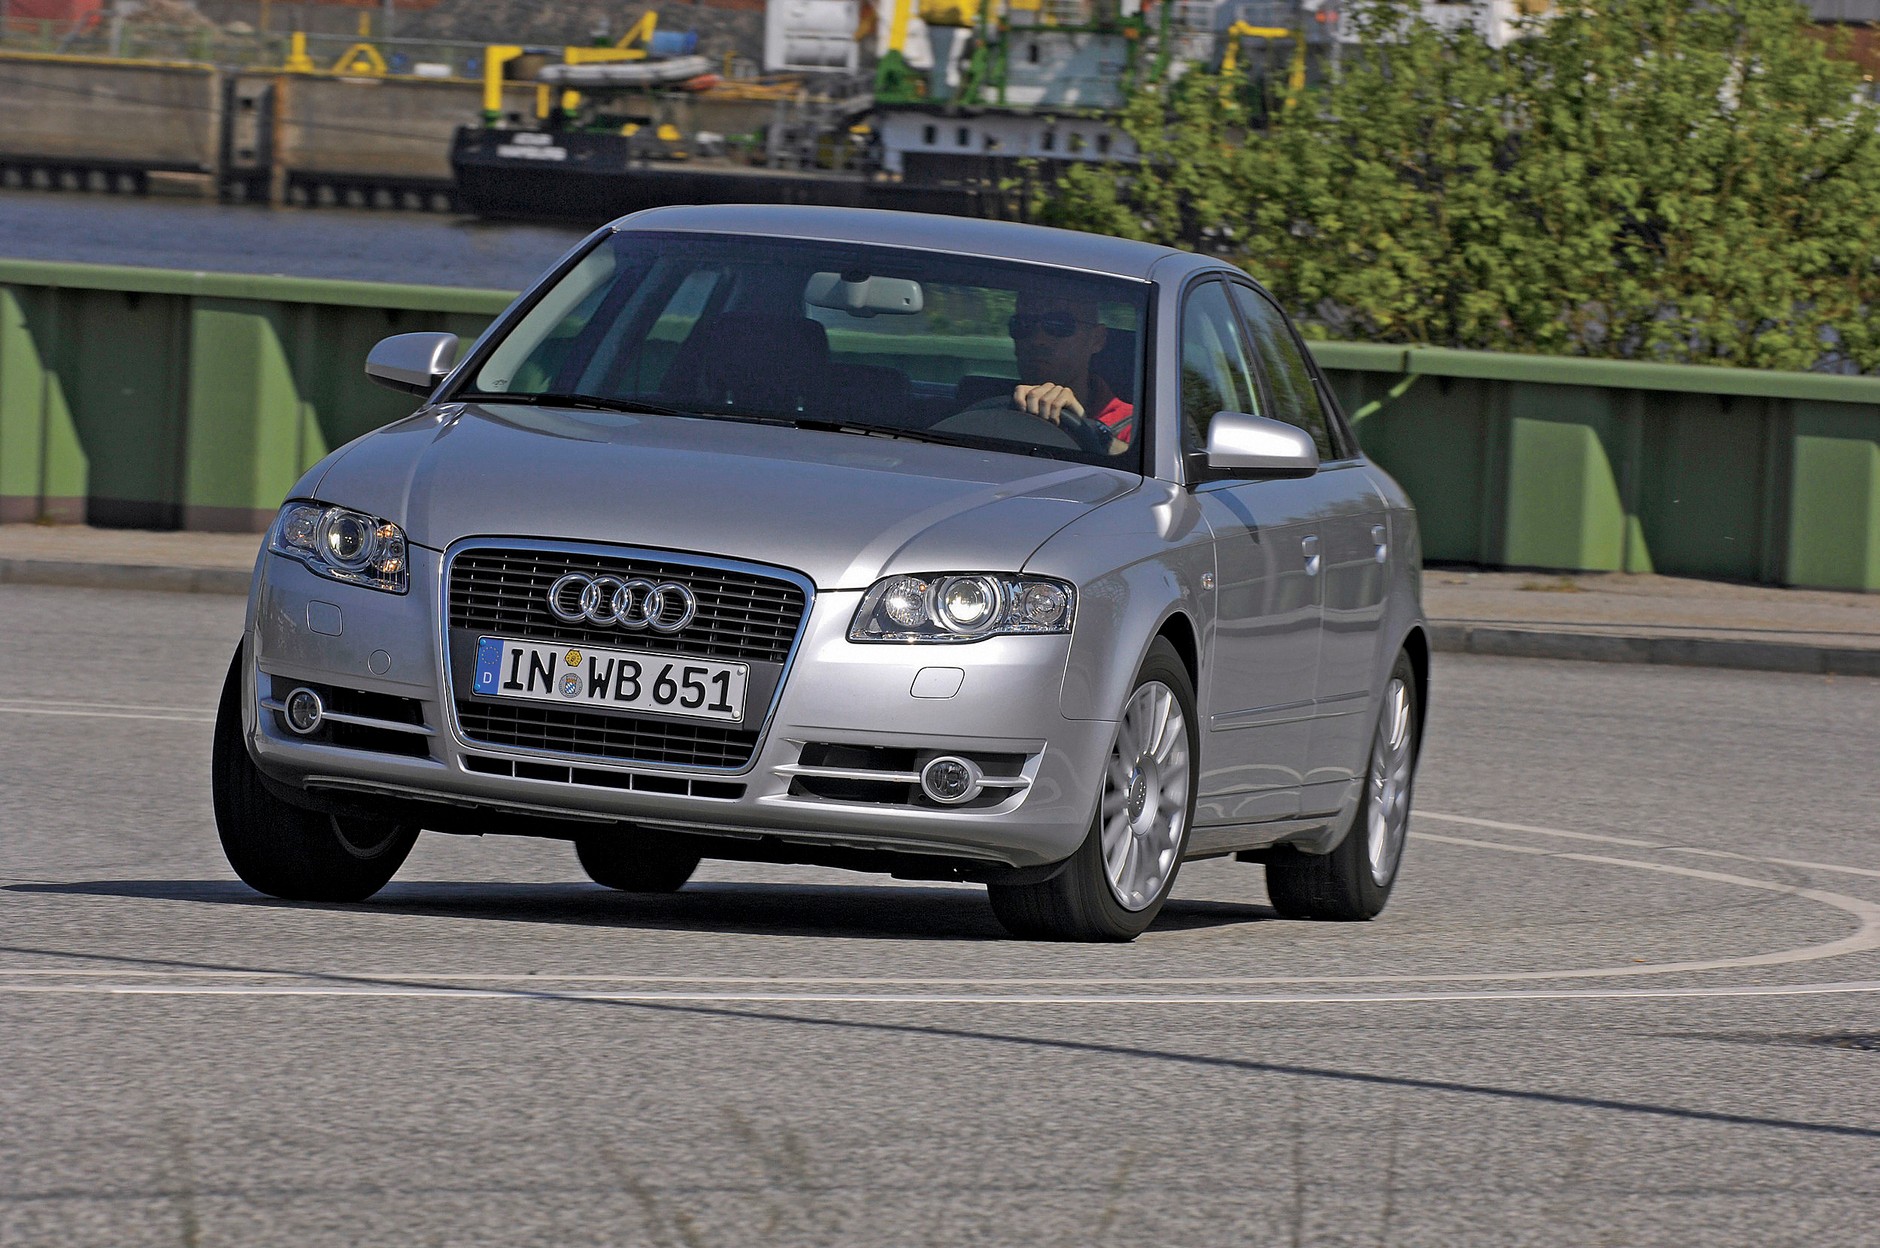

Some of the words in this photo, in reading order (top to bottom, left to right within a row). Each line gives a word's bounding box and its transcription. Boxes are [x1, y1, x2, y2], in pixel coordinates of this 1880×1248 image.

[482, 672, 491, 684] D
[503, 649, 557, 694] IN
[588, 656, 642, 702] WB
[653, 664, 733, 713] 651
